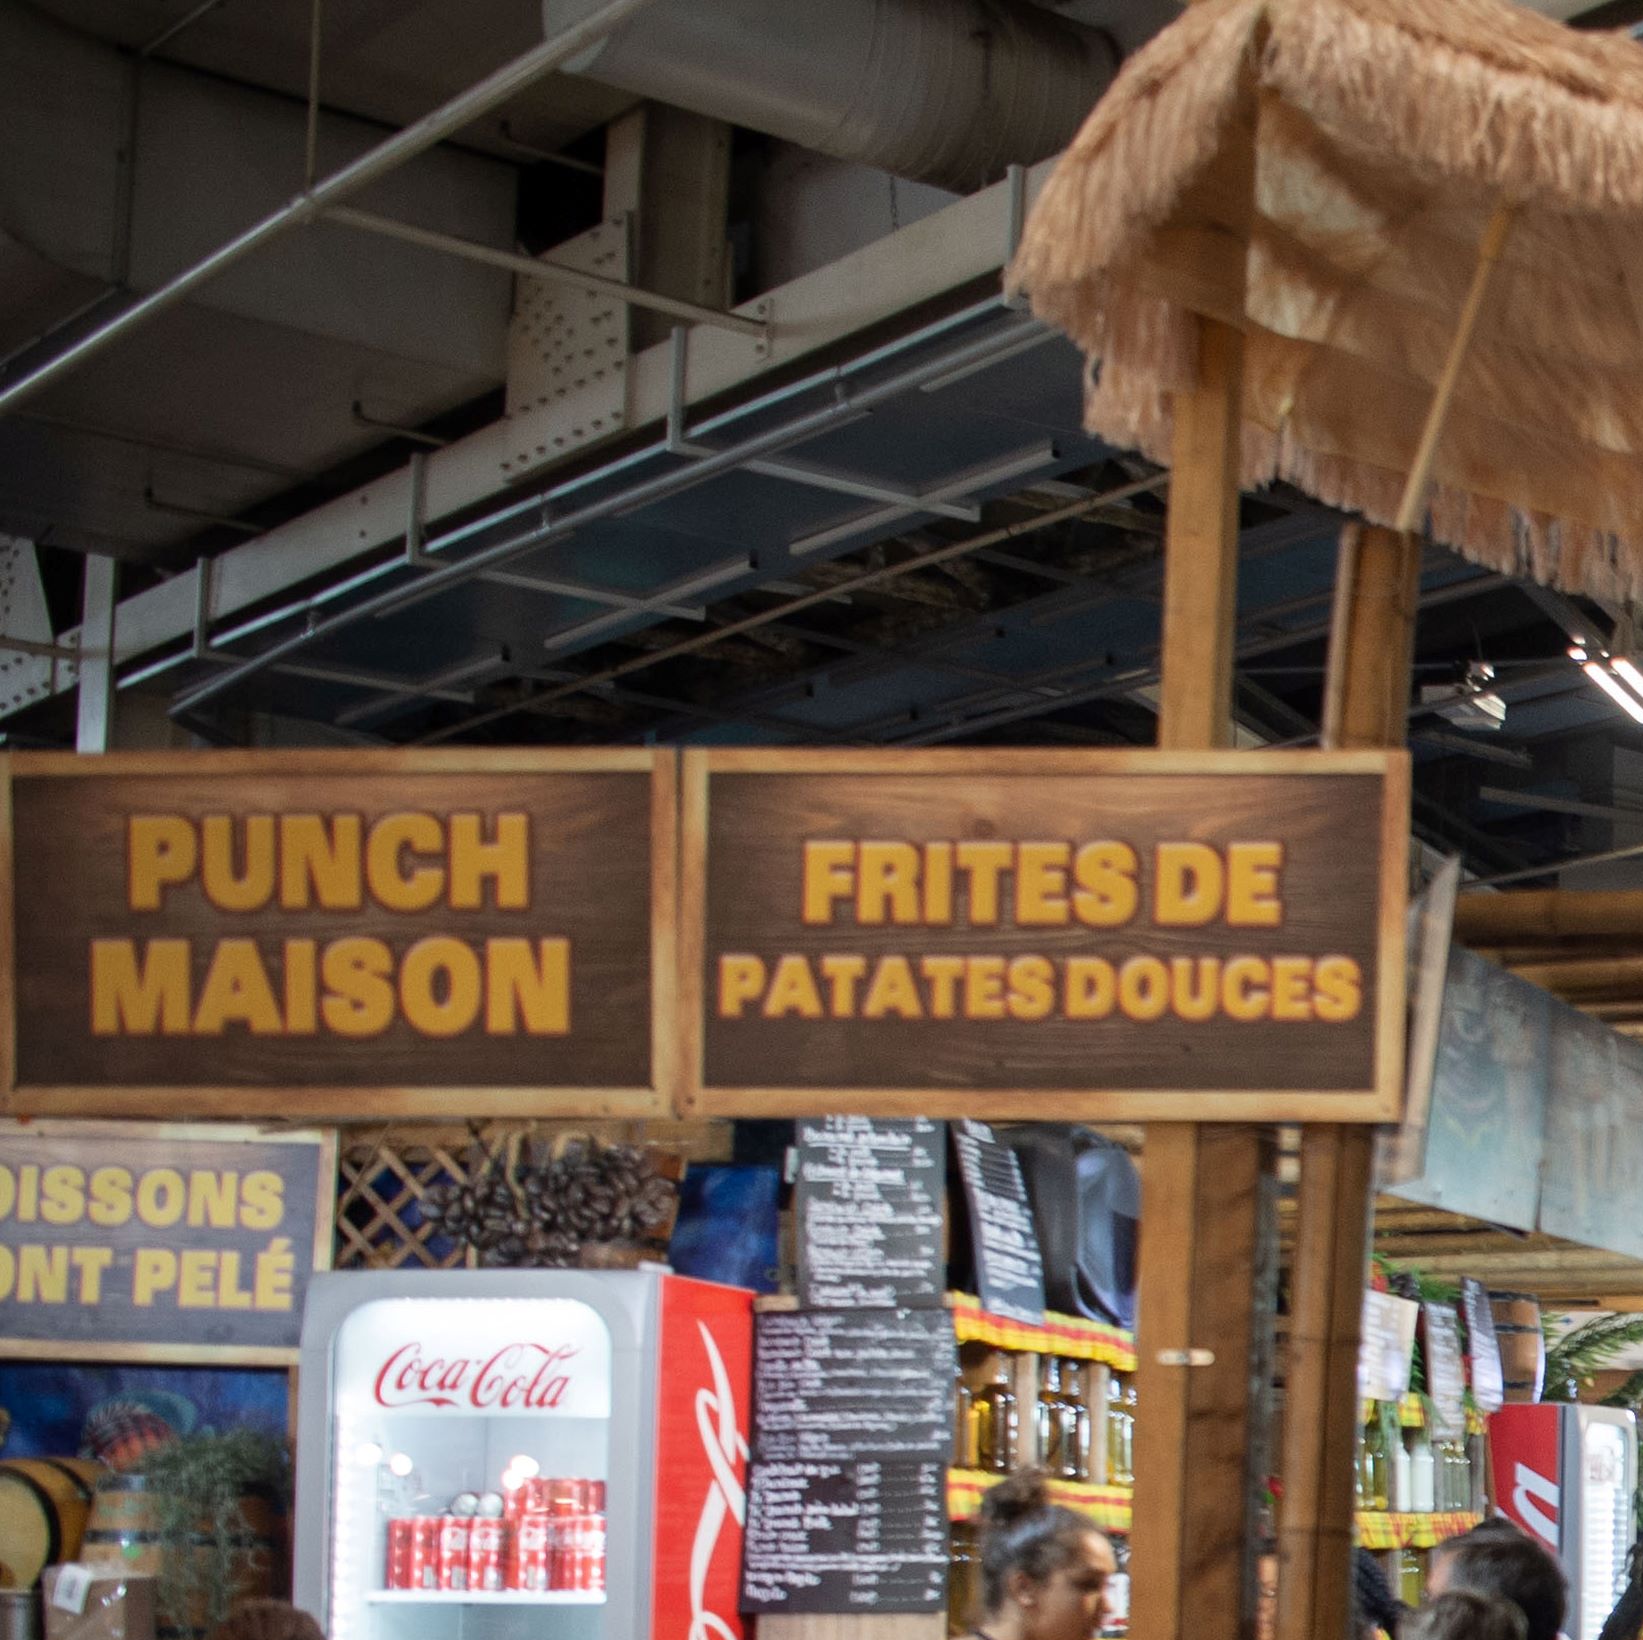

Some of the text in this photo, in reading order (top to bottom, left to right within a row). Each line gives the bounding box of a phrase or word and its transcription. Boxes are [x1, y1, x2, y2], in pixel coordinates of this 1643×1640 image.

[126, 810, 531, 912] PUNCH
[802, 839, 1284, 929] FRITES DE
[90, 935, 572, 1038] MAISON
[716, 953, 1363, 1024] PATATES DOUCES
[132, 1236, 296, 1312] PELÉ
